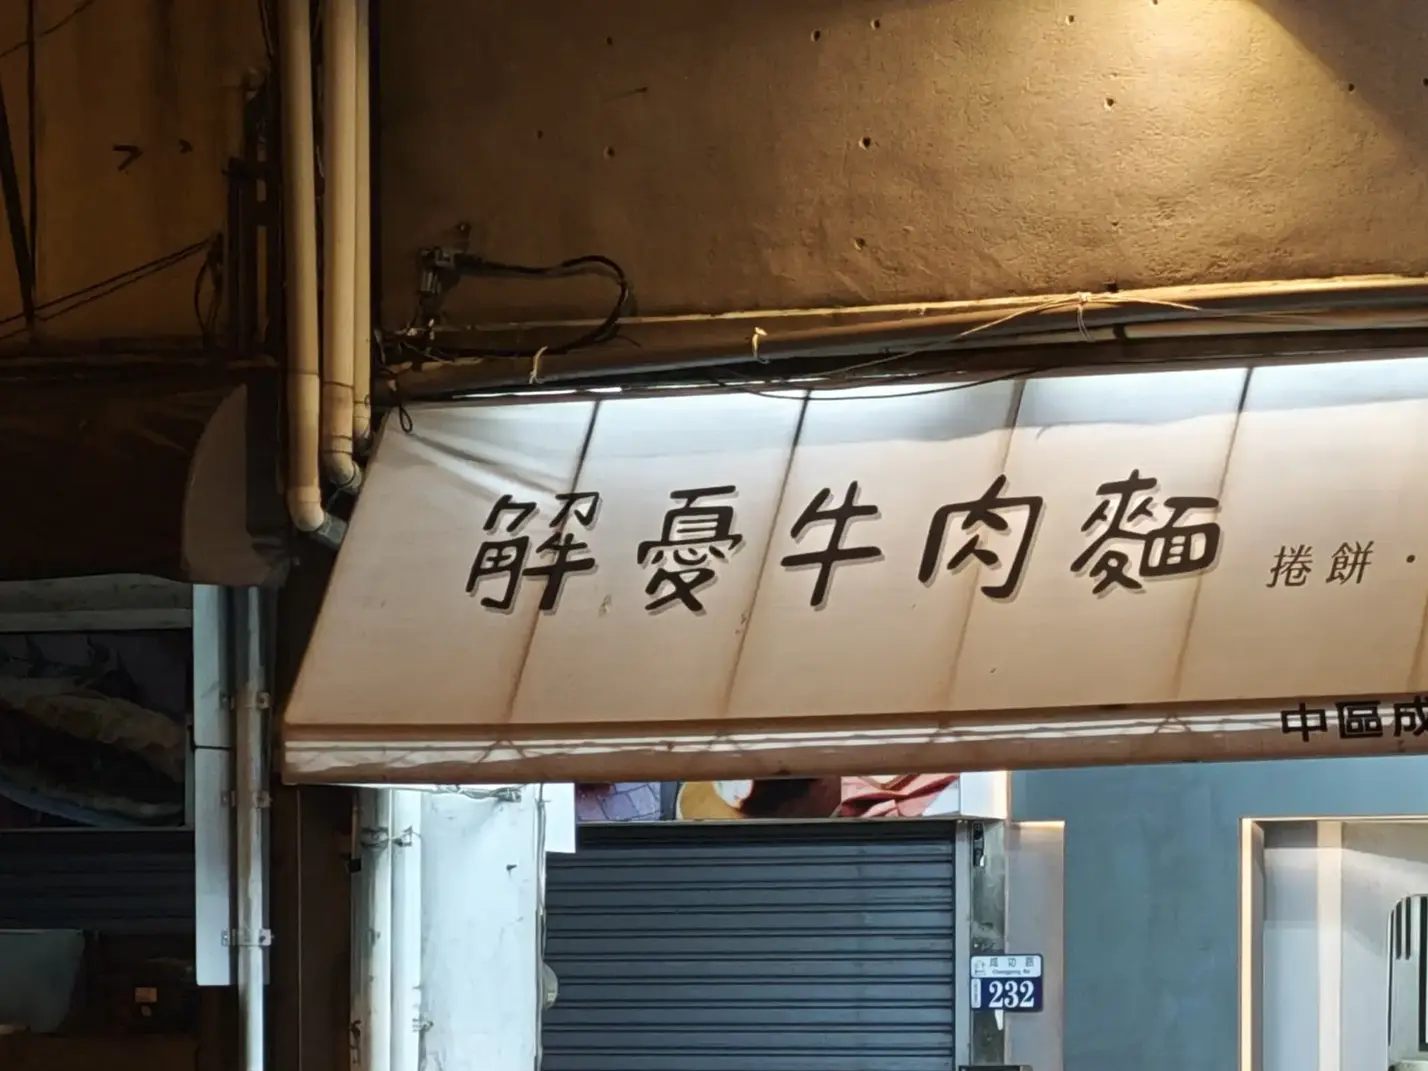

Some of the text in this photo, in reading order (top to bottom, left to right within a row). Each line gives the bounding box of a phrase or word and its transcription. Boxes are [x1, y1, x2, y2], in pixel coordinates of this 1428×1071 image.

[466, 469, 1221, 613] 解憂牛肉麵
[988, 980, 1035, 1009] 232
